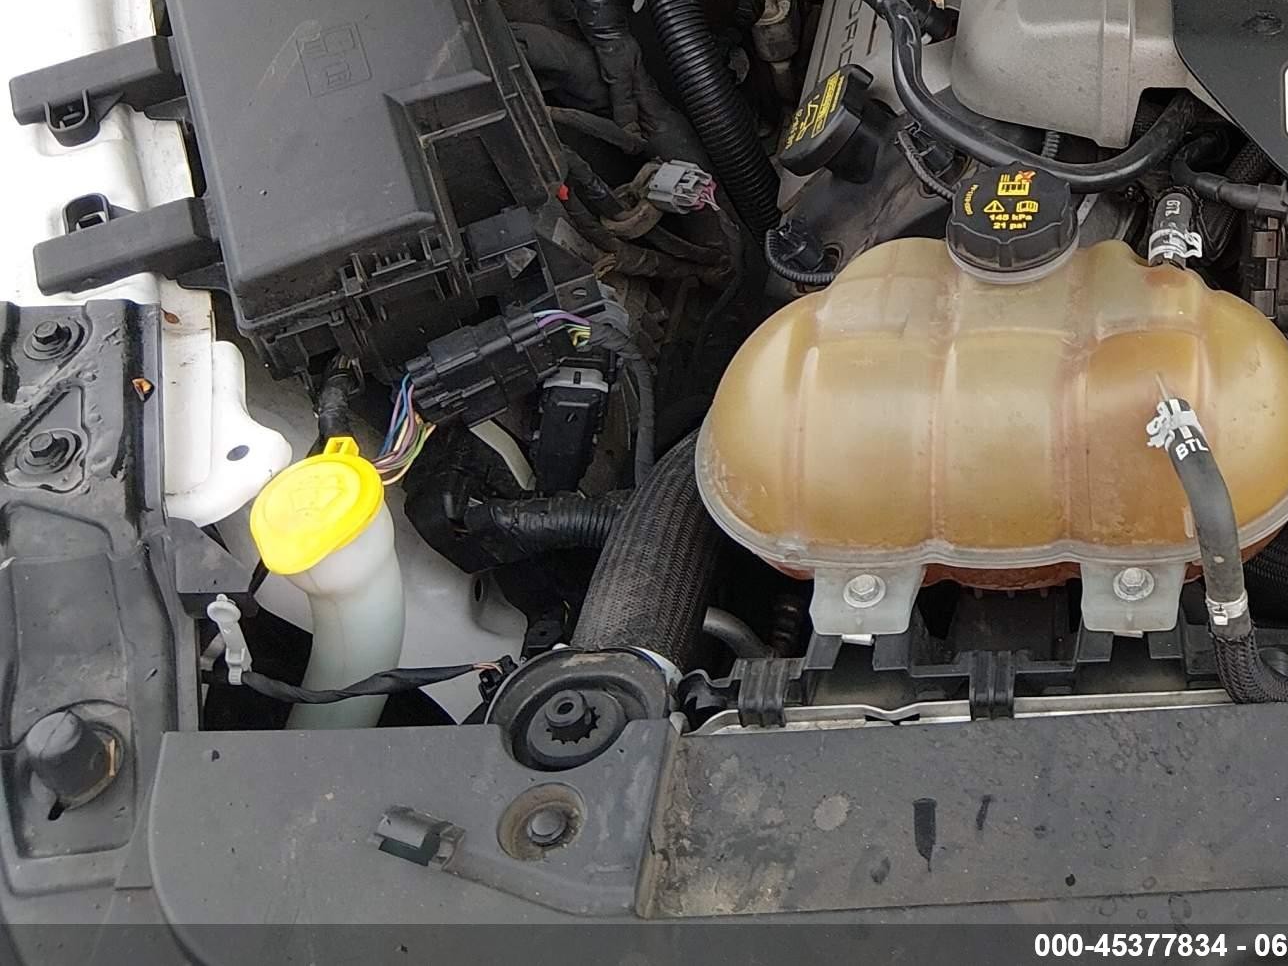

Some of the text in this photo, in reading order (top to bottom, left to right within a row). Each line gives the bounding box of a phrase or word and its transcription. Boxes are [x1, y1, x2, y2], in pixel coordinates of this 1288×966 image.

[1011, 213, 1033, 221] kPa
[992, 221, 1006, 230] 21
[1176, 438, 1209, 461] BTL
